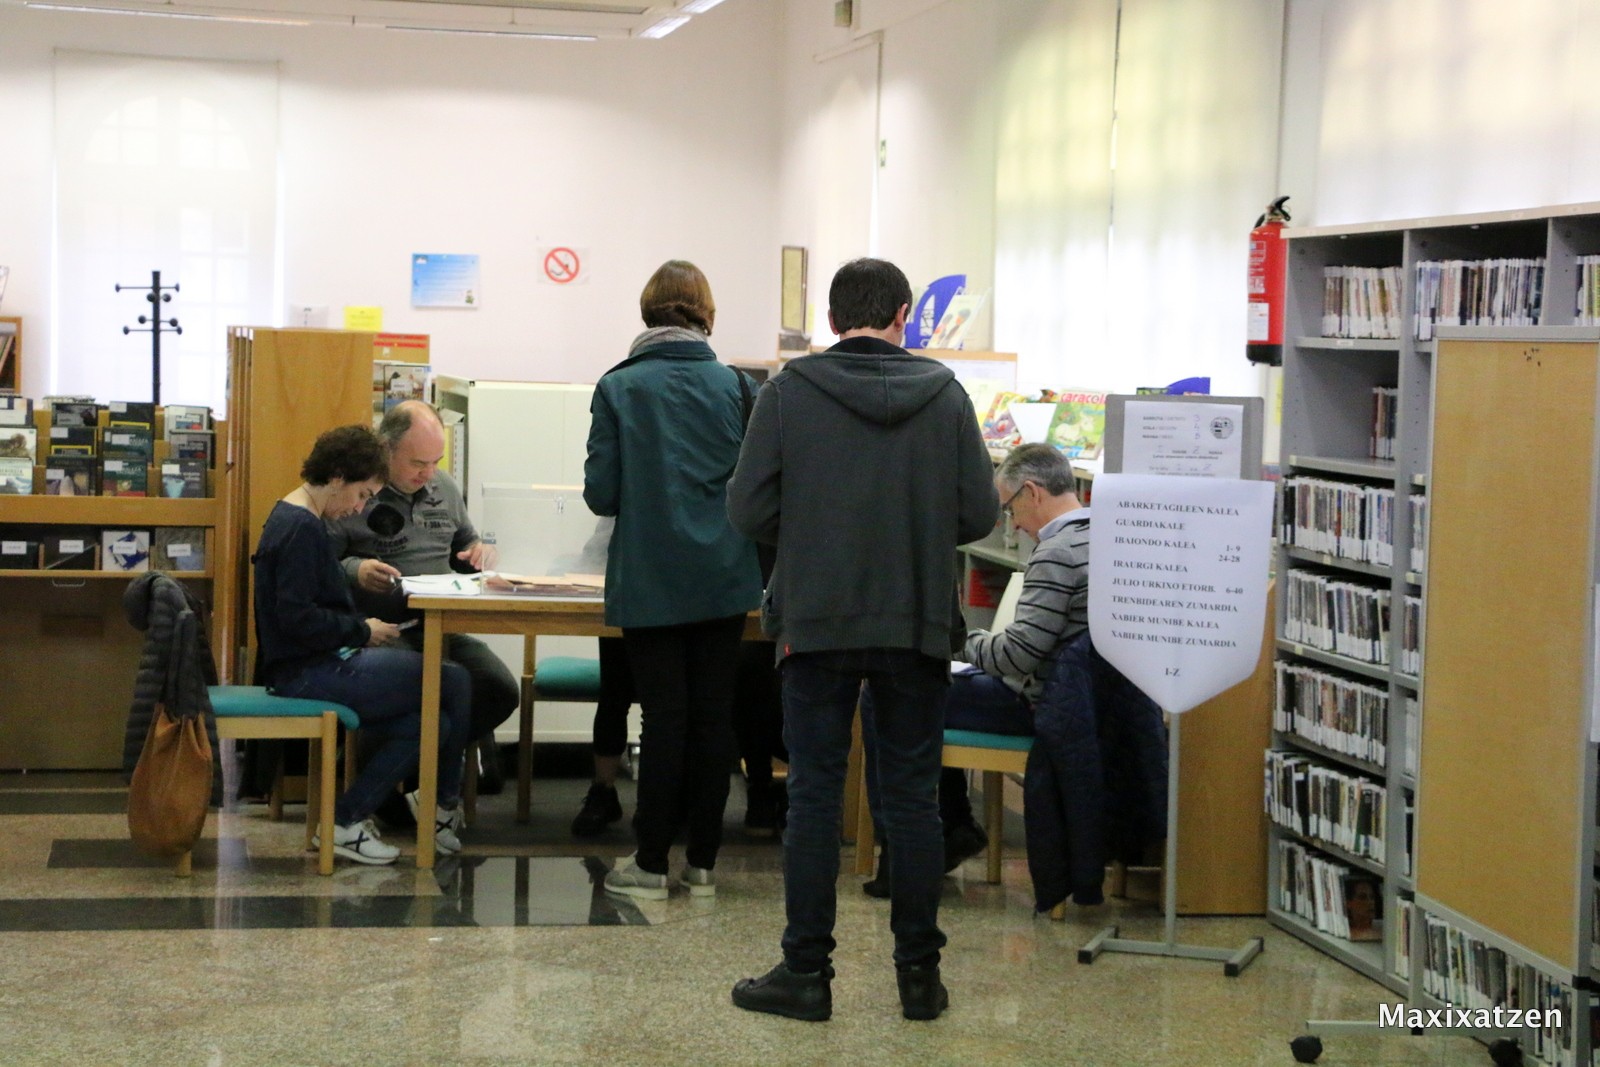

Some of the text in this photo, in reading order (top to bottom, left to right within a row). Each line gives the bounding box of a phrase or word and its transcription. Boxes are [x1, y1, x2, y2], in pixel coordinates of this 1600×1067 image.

[1060, 391, 1106, 405] caracol
[1116, 501, 1240, 516] ABARKETAGILEEN KALEA
[1114, 536, 1162, 548] IBAIONDO
[1163, 539, 1196, 550] KALEA
[1218, 555, 1240, 563] 24-28
[1113, 560, 1188, 573] IRAURGI KALEA
[1112, 577, 1140, 587] JULIO
[1142, 580, 1180, 591] URKIXO
[1182, 583, 1216, 593] ETORB.
[1112, 595, 1238, 613] TRENBIDEAREN ZUMARDIA
[1111, 613, 1220, 630] XABIER MUNIBE KALEA
[1111, 630, 1237, 648] XABIER MUNIBE ZUMARDIA
[1165, 667, 1180, 677] I-Z
